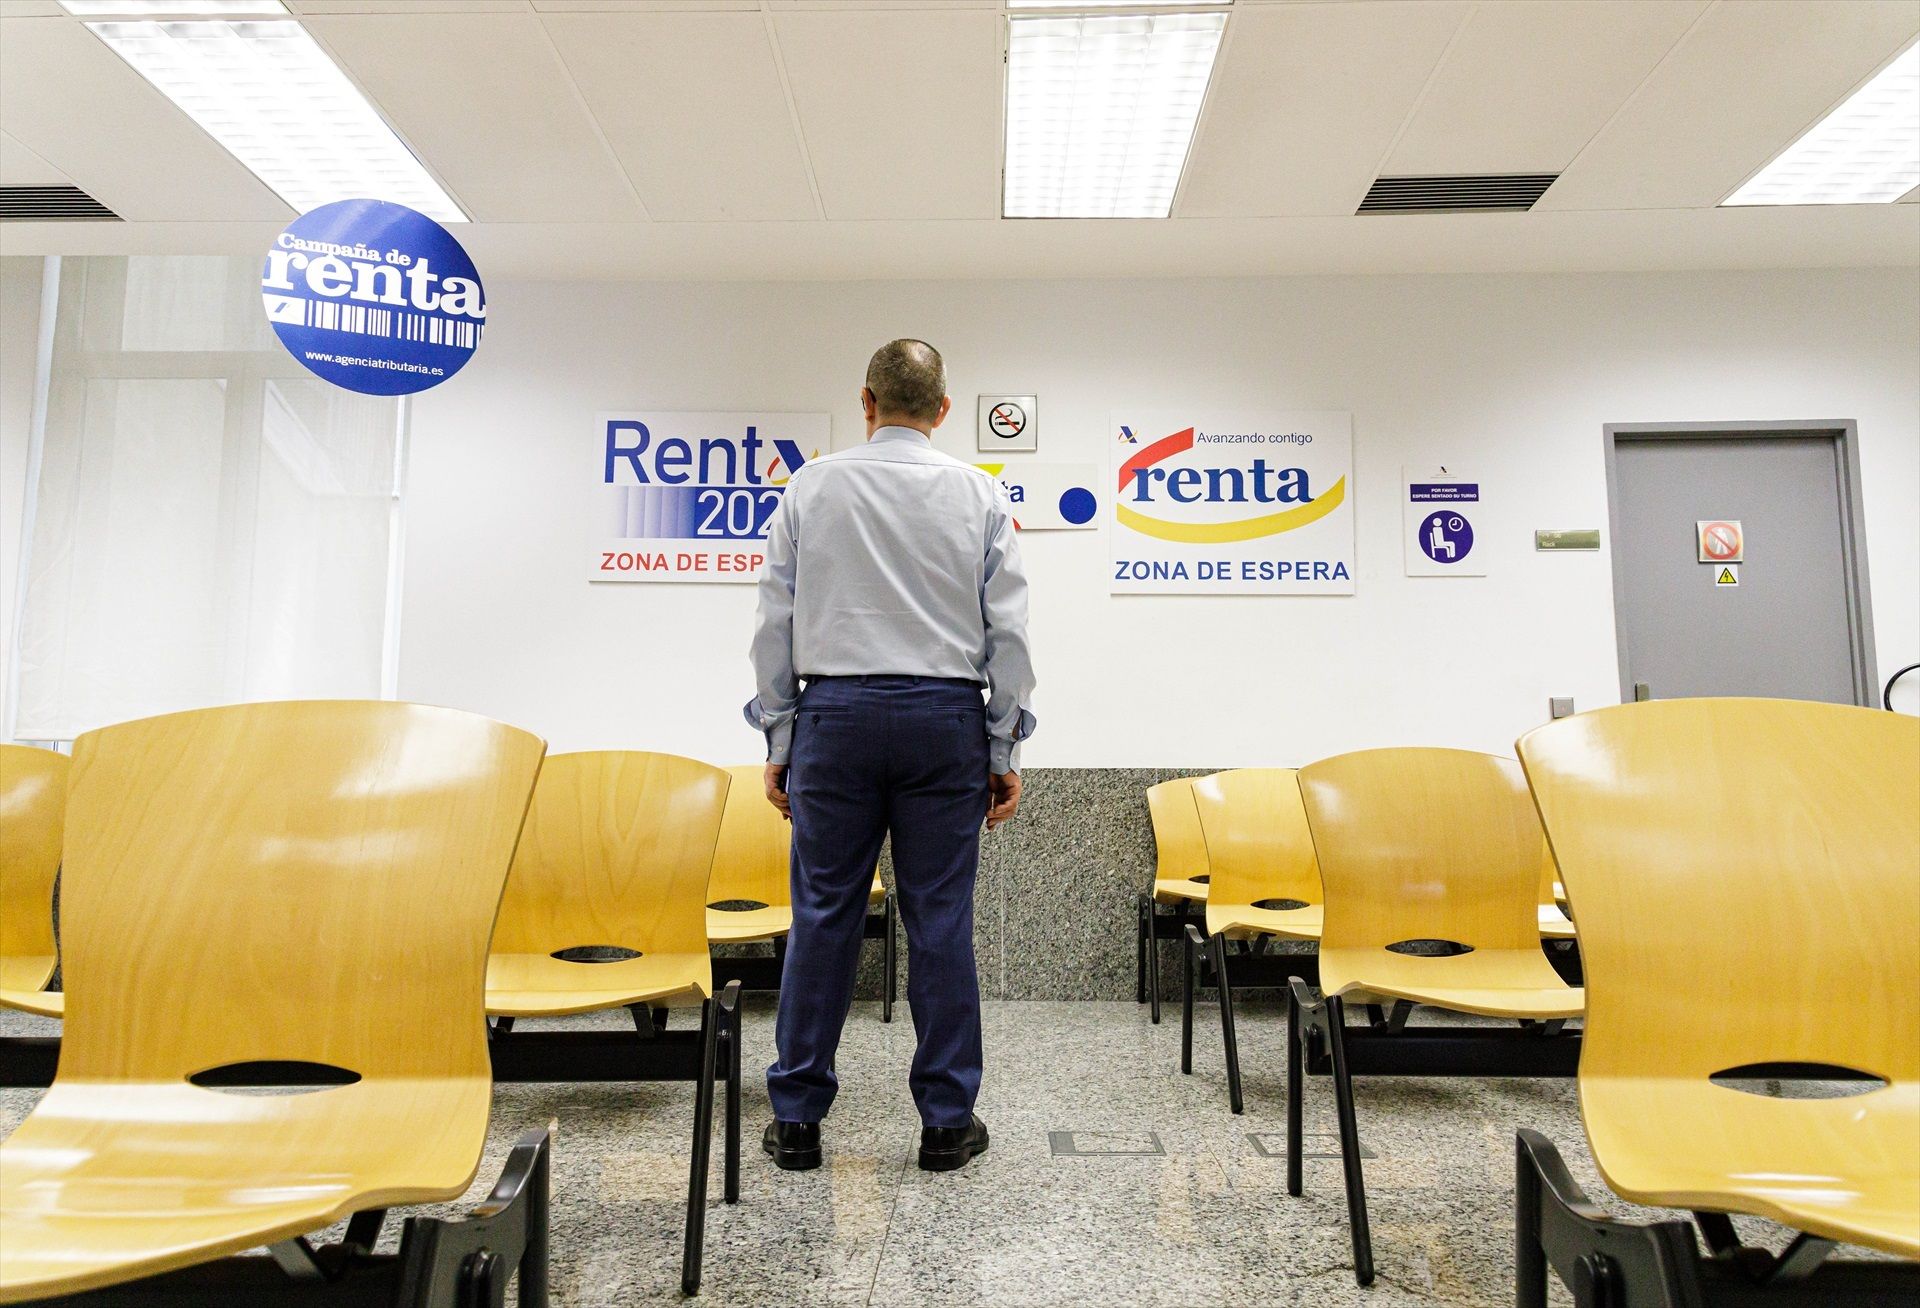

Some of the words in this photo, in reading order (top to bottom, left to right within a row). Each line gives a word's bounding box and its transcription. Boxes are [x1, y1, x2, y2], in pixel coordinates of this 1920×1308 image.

[278, 232, 381, 262] Campaña
[385, 249, 411, 266] de
[262, 250, 486, 318] renta
[305, 351, 444, 376] www.agenciatributaria.es
[1197, 432, 1266, 444] Avanzando
[1268, 432, 1313, 446] contigo
[1131, 459, 1315, 503] renta
[697, 489, 783, 536] 202
[600, 552, 669, 571] ZONA
[676, 553, 709, 572] DE
[716, 553, 764, 572] ESP
[1115, 561, 1189, 580] ZONA
[1197, 561, 1232, 580] DE
[1241, 561, 1350, 581] ESPERA
